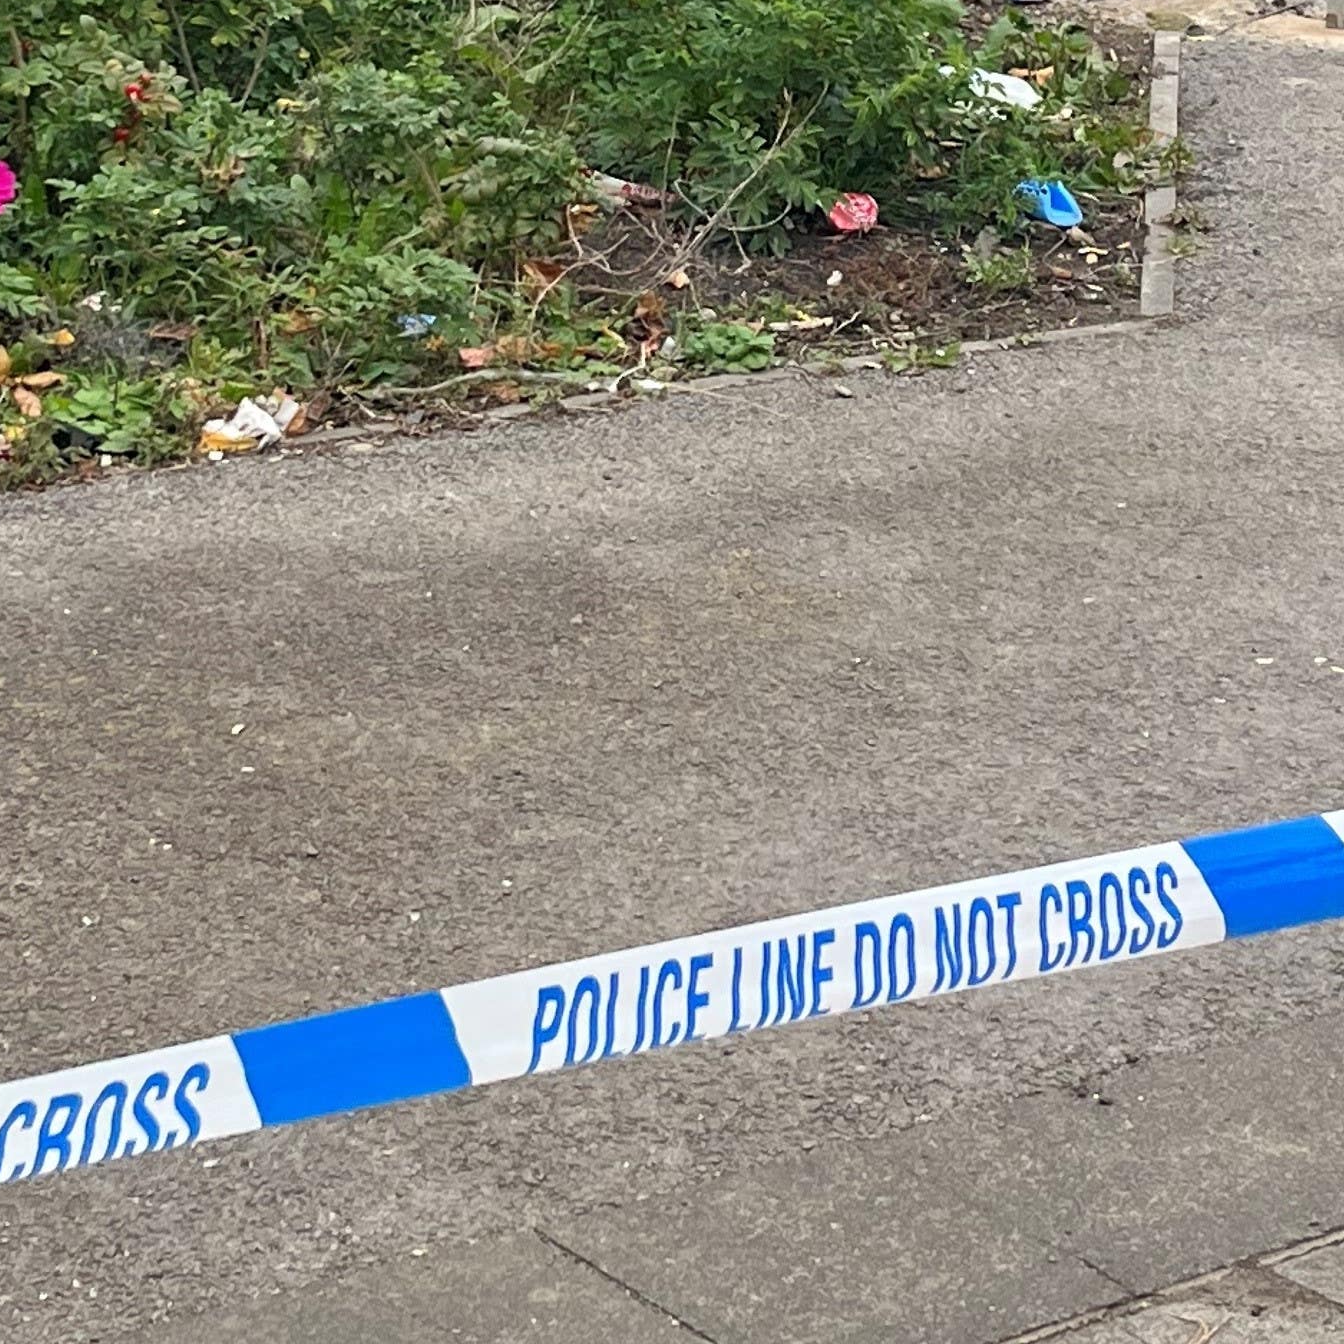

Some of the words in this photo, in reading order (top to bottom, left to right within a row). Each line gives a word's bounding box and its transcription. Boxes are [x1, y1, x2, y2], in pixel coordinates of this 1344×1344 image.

[528, 954, 715, 1072] POLICE
[727, 929, 835, 1032] LINE
[854, 912, 917, 1003] DO
[933, 892, 1022, 993] NOT
[1039, 861, 1183, 972] CROSS
